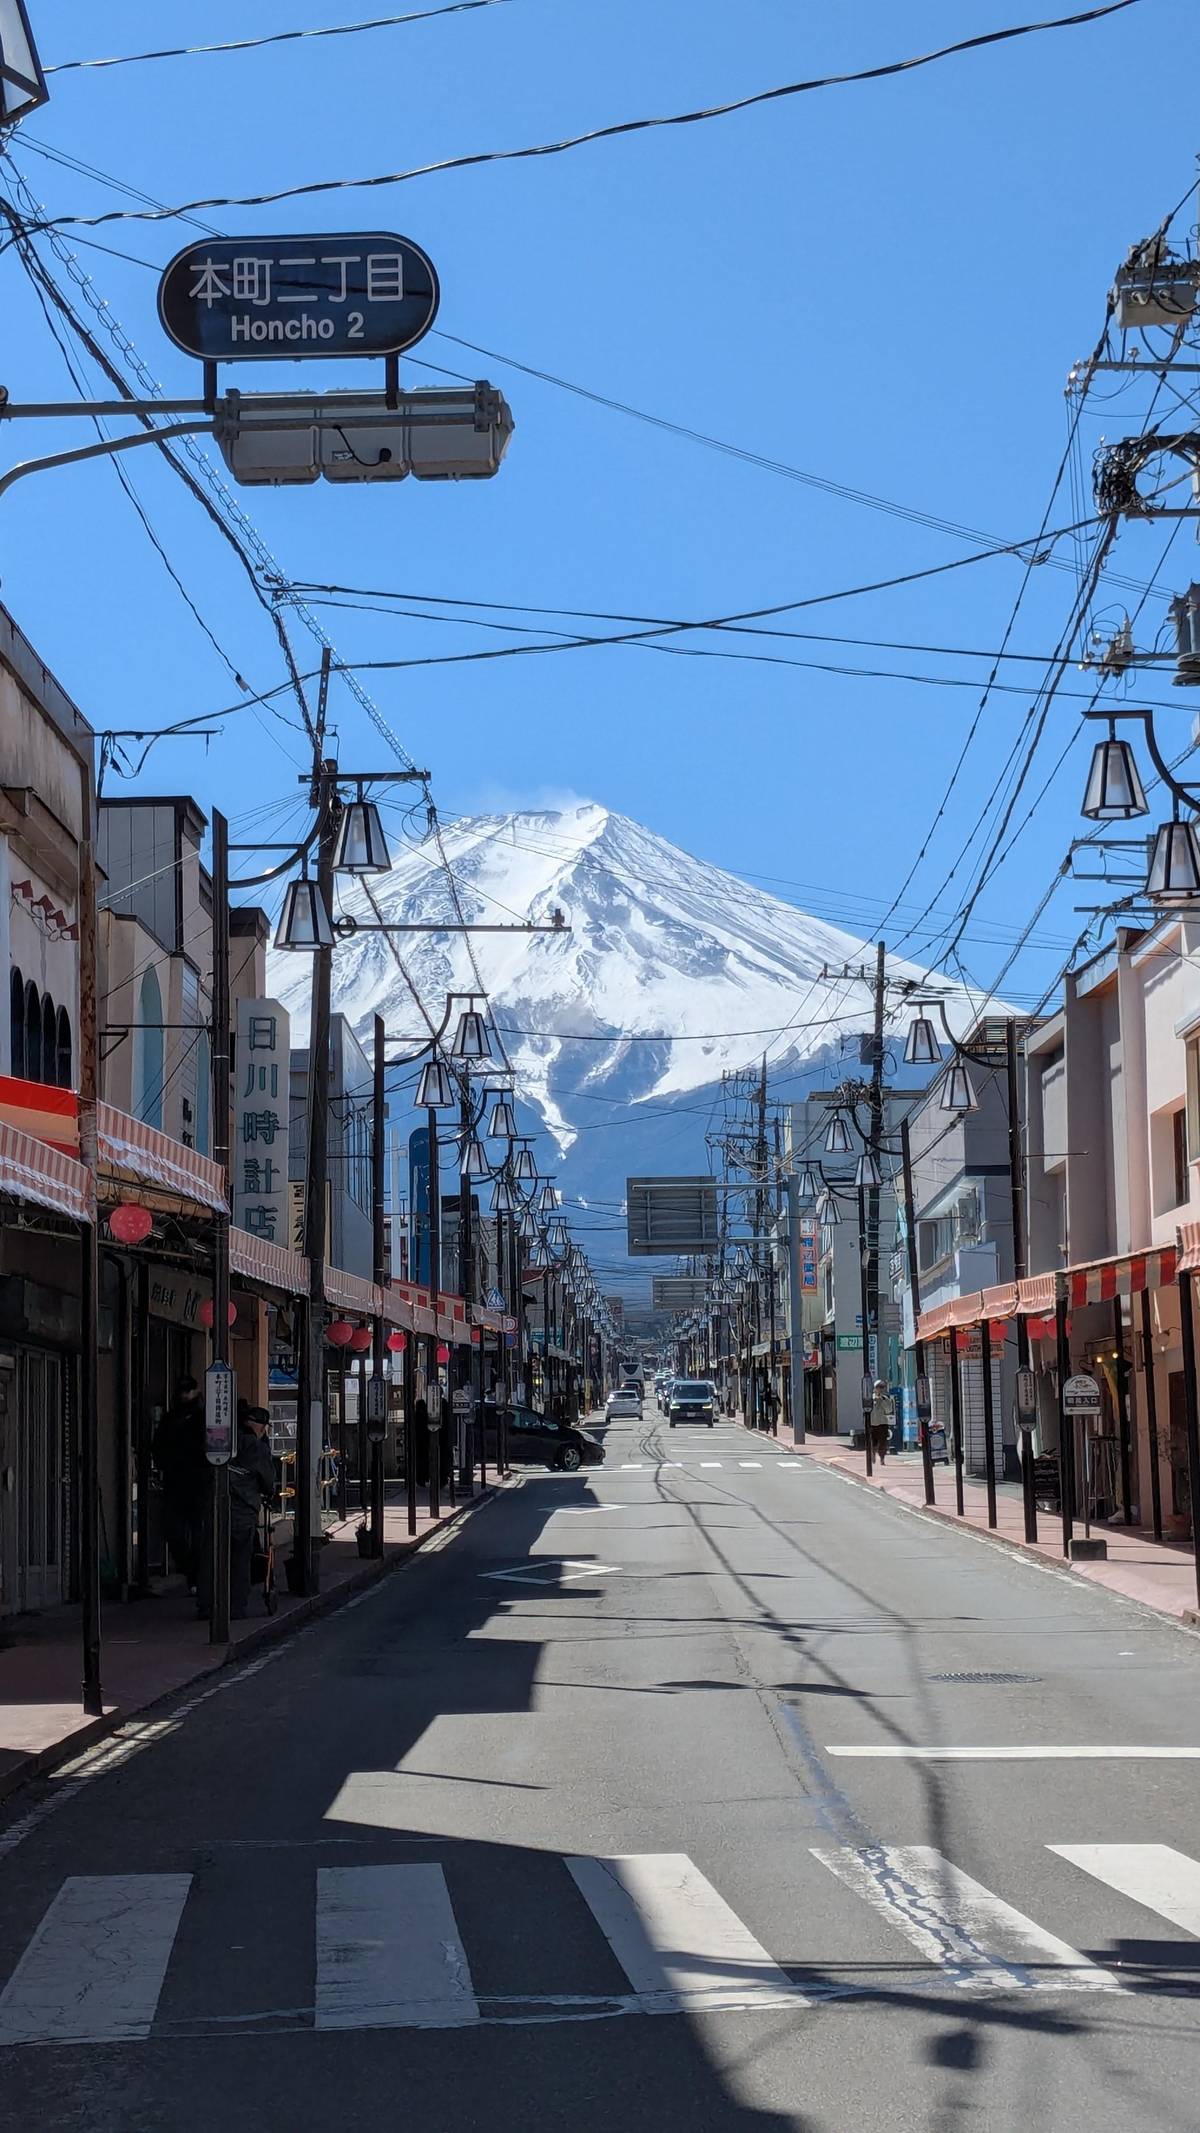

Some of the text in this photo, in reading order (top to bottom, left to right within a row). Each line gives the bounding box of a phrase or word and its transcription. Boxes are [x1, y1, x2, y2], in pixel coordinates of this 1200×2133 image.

[189, 254, 402, 309] 本町二丁目
[231, 312, 364, 341] Honcho 2
[244, 1016, 280, 1240] 日川時計店
